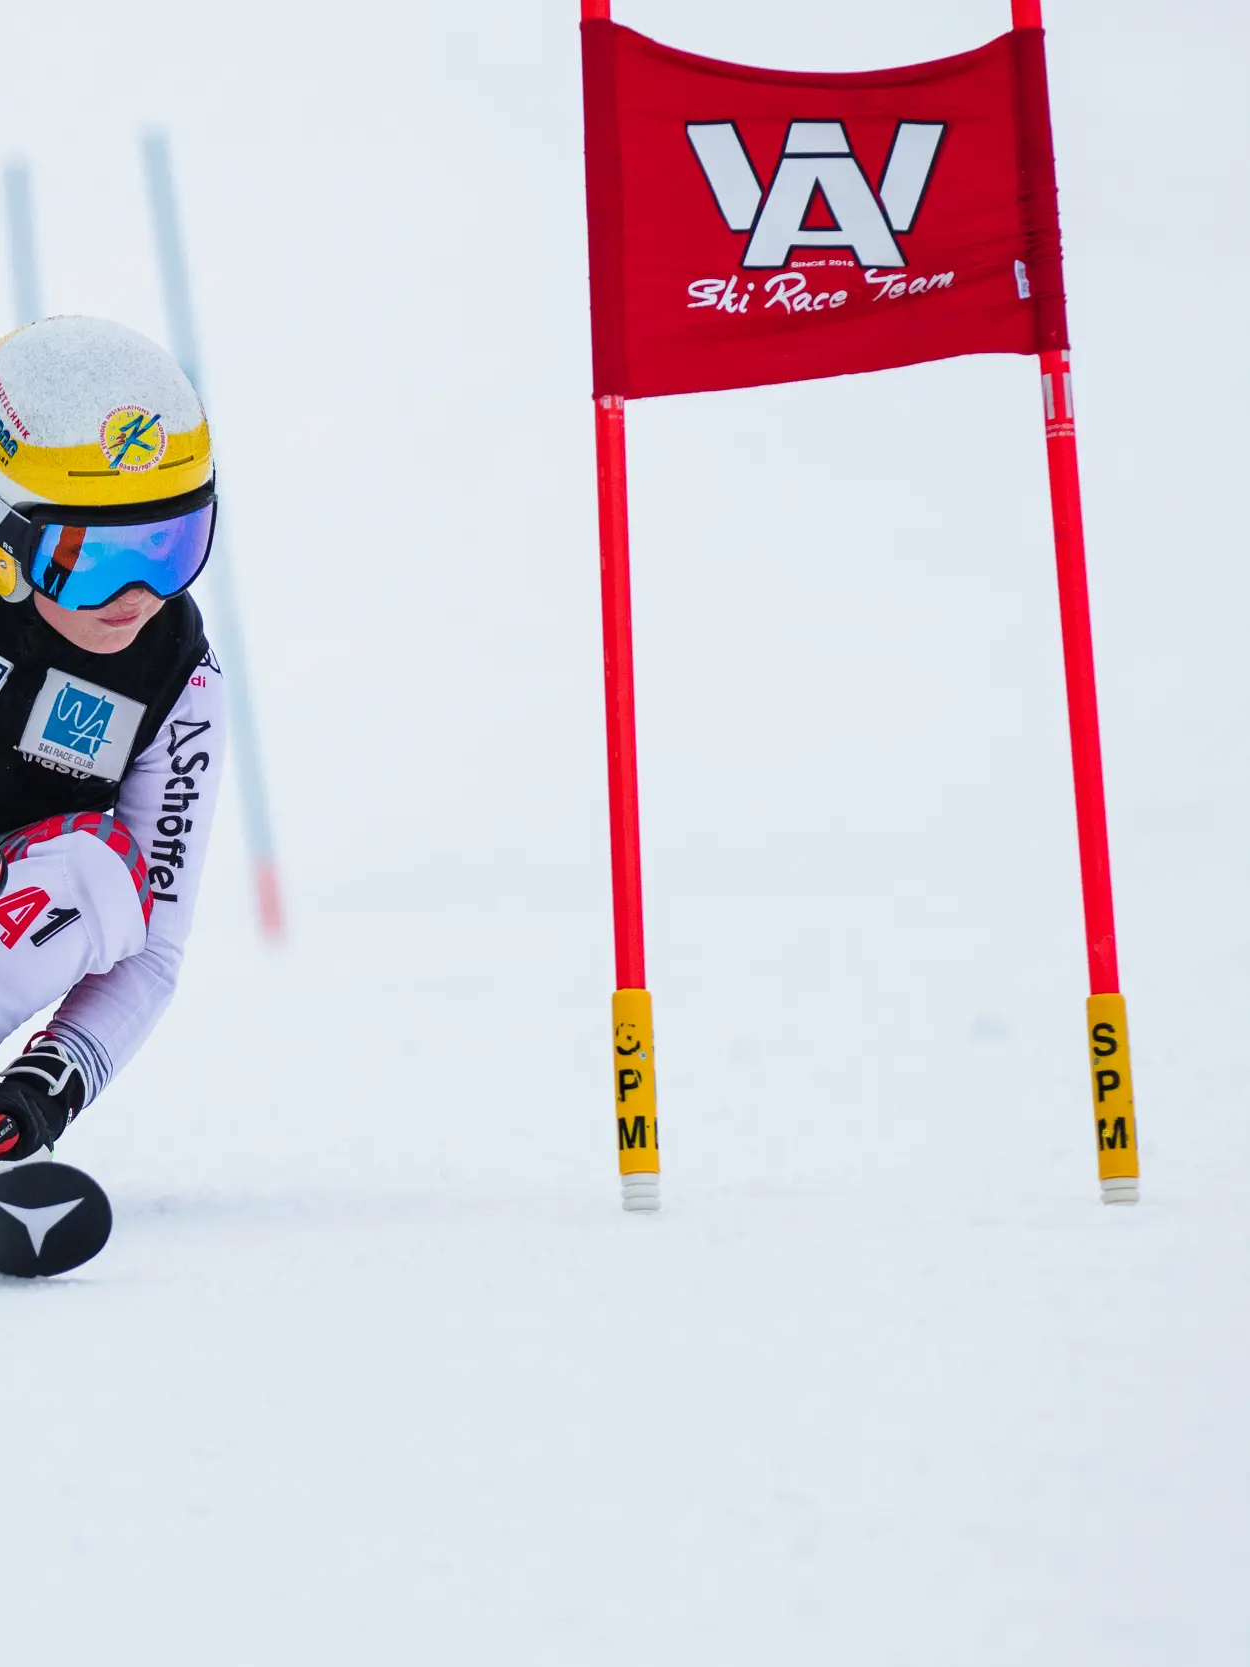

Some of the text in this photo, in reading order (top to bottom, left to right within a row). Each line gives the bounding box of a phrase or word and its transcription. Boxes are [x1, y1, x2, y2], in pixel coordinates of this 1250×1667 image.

[790, 260, 826, 268] SINCE
[687, 268, 954, 315] Ski Race Team
[2, 541, 14, 554] RS
[37, 742, 95, 770] SKI RACE CLUB
[148, 751, 210, 903] Schöffel
